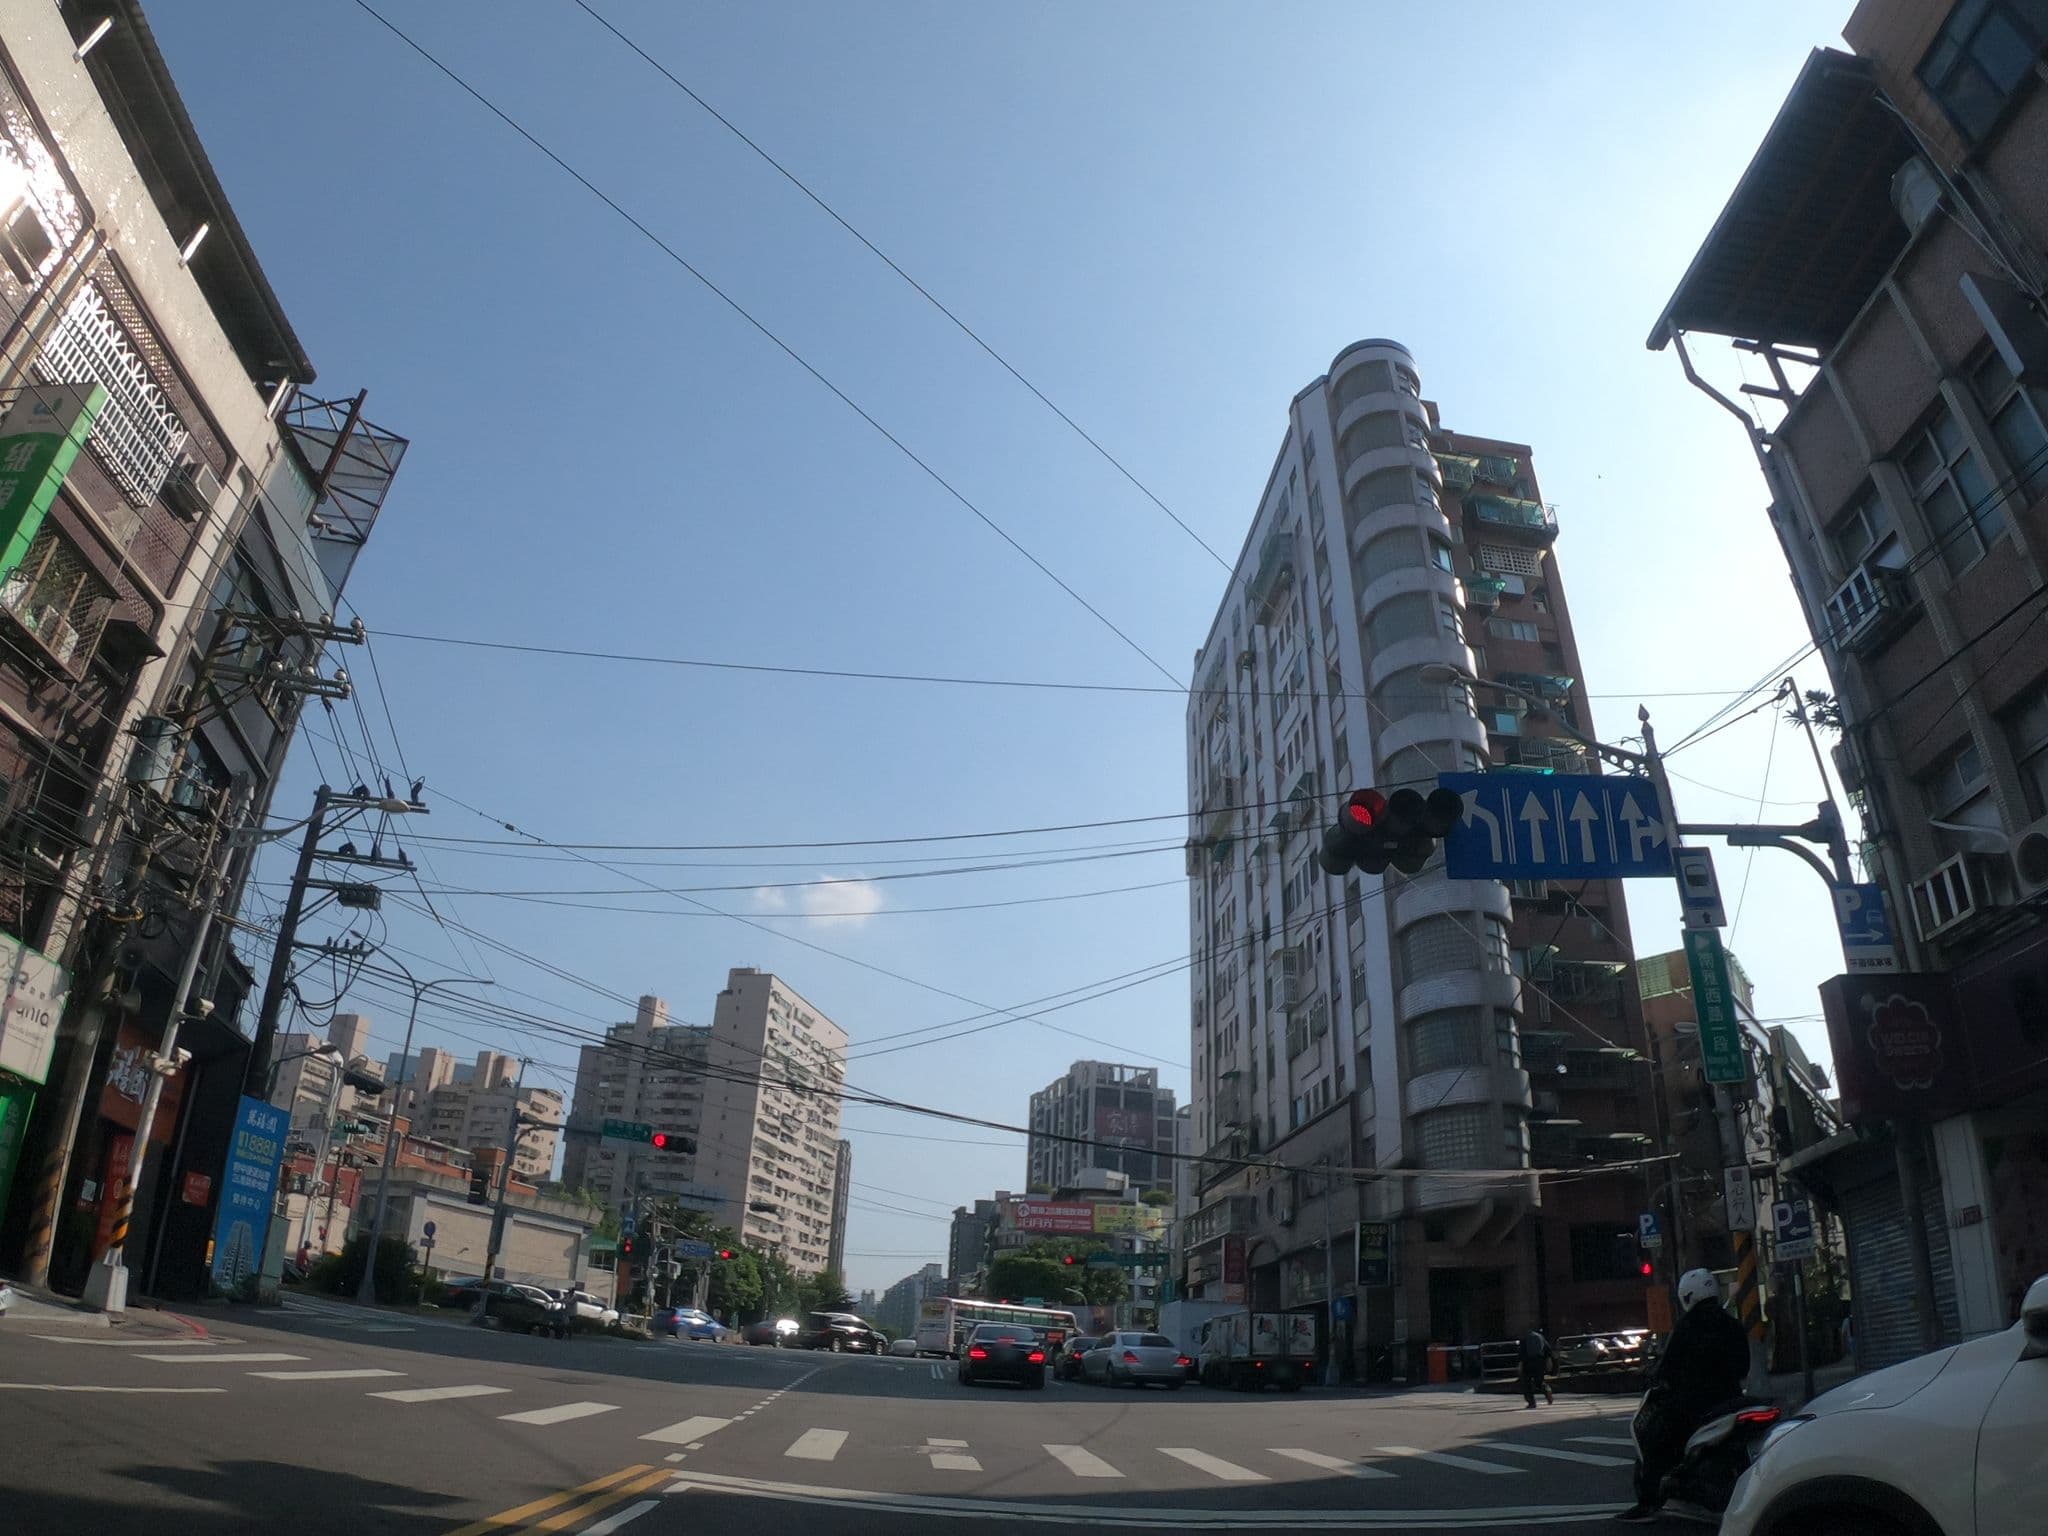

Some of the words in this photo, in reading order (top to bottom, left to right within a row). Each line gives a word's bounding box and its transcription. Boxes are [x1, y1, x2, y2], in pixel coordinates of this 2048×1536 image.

[1837, 888, 1862, 924] P
[1639, 1214, 1654, 1234] P
[1773, 1203, 1793, 1241] P
